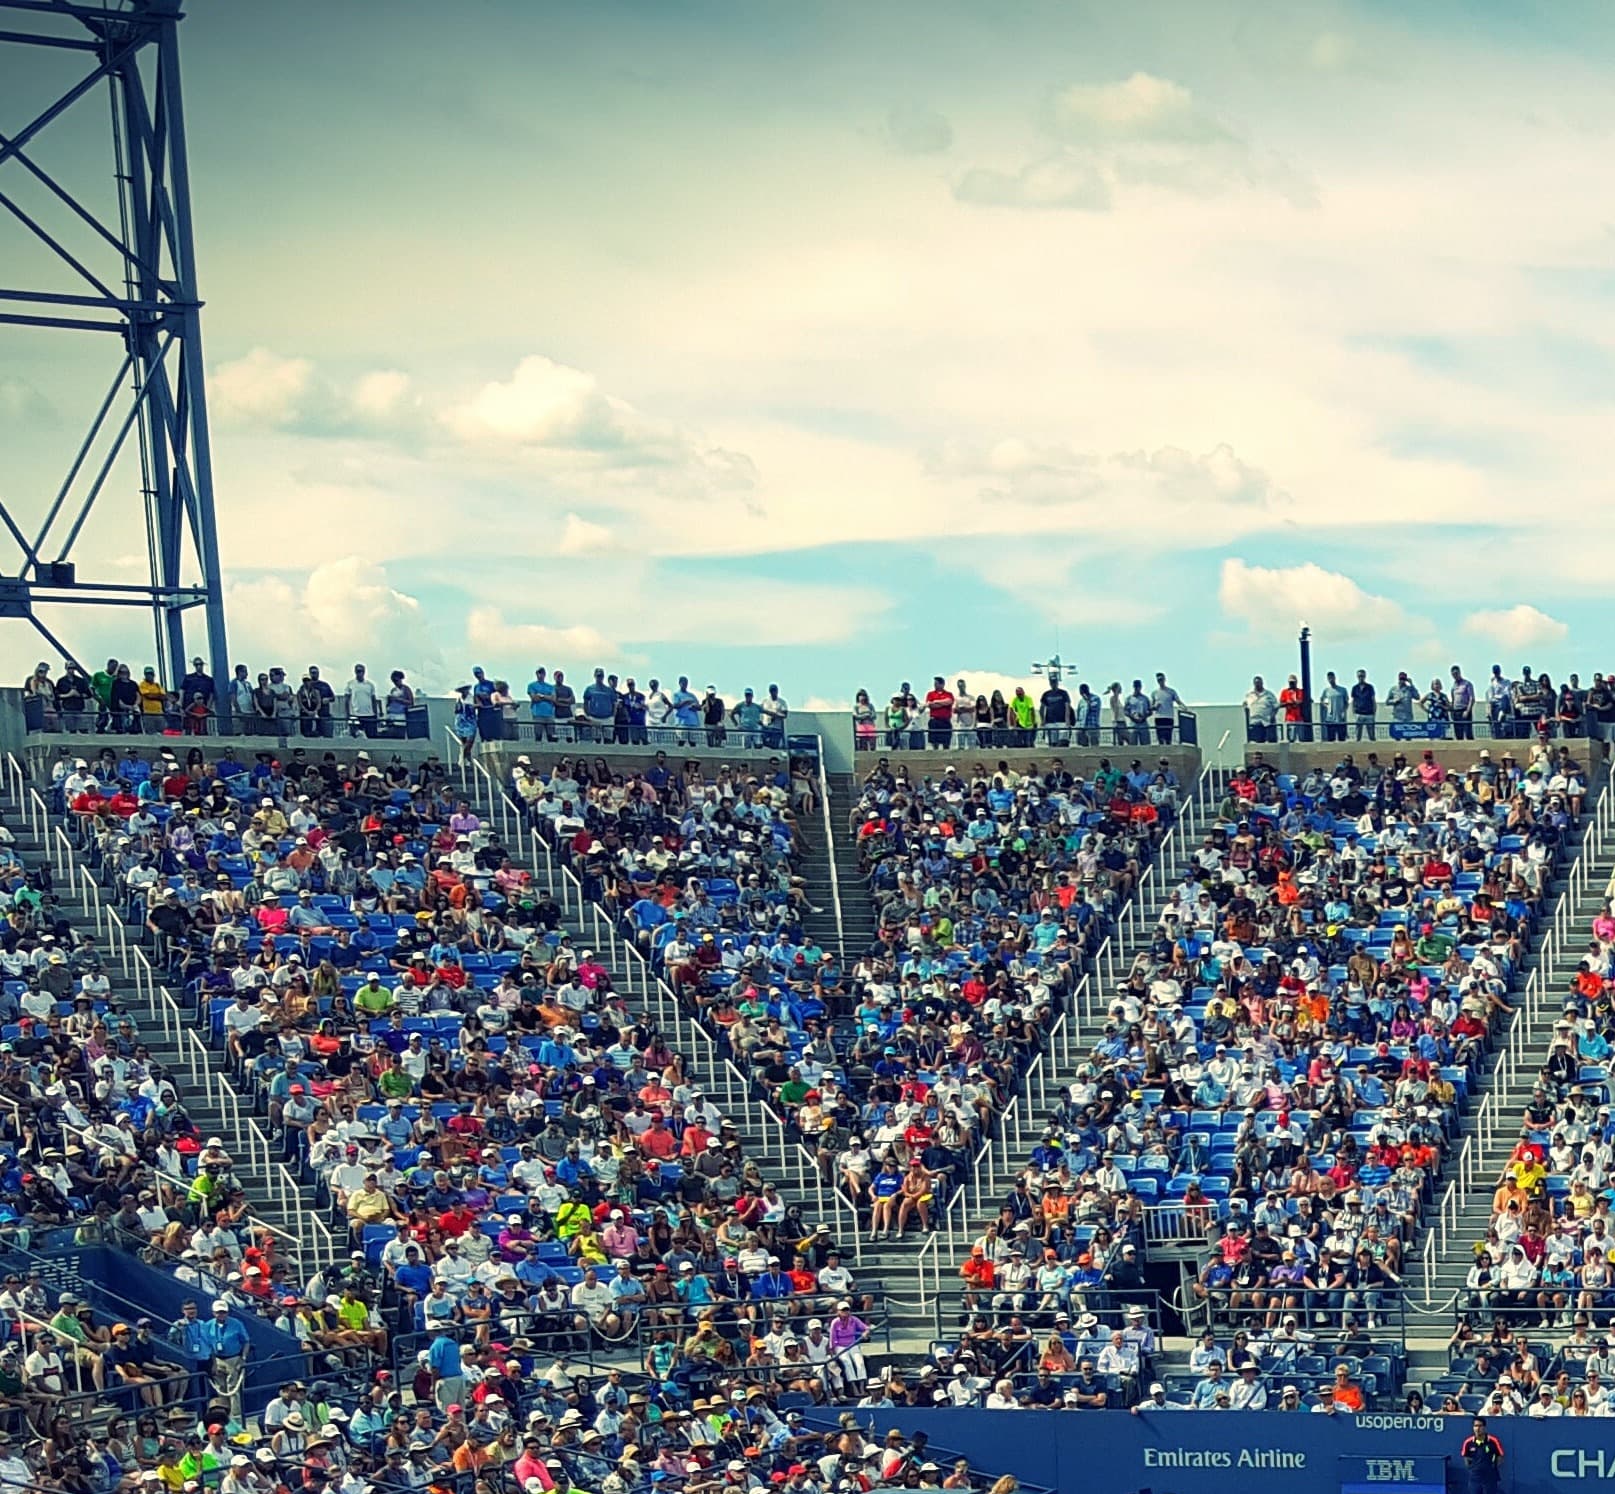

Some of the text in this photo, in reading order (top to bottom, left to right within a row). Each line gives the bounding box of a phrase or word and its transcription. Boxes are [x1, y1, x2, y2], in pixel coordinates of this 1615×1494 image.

[1355, 1415, 1444, 1432] usopen.org
[1144, 1448, 1306, 1469] Emirates Airline
[1366, 1459, 1415, 1481] IBM
